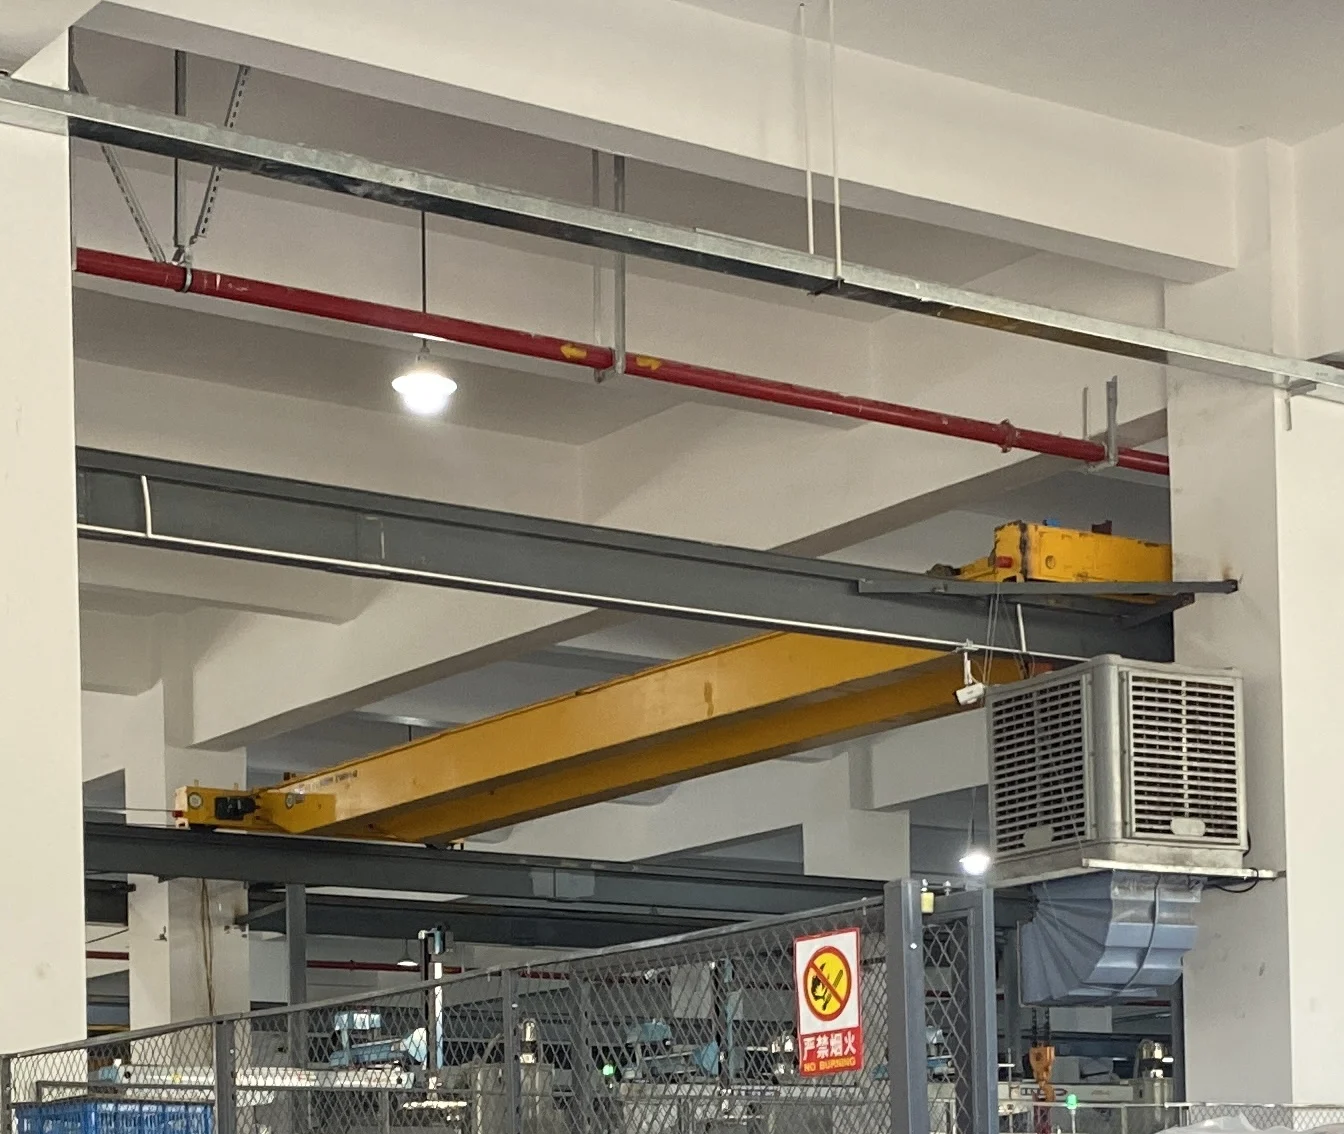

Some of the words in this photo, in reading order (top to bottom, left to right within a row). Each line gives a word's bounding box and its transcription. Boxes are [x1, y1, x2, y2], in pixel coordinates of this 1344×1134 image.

[802, 1031, 856, 1061] 严禁烟火
[803, 1062, 816, 1073] NO
[819, 1057, 856, 1071] BURNING
